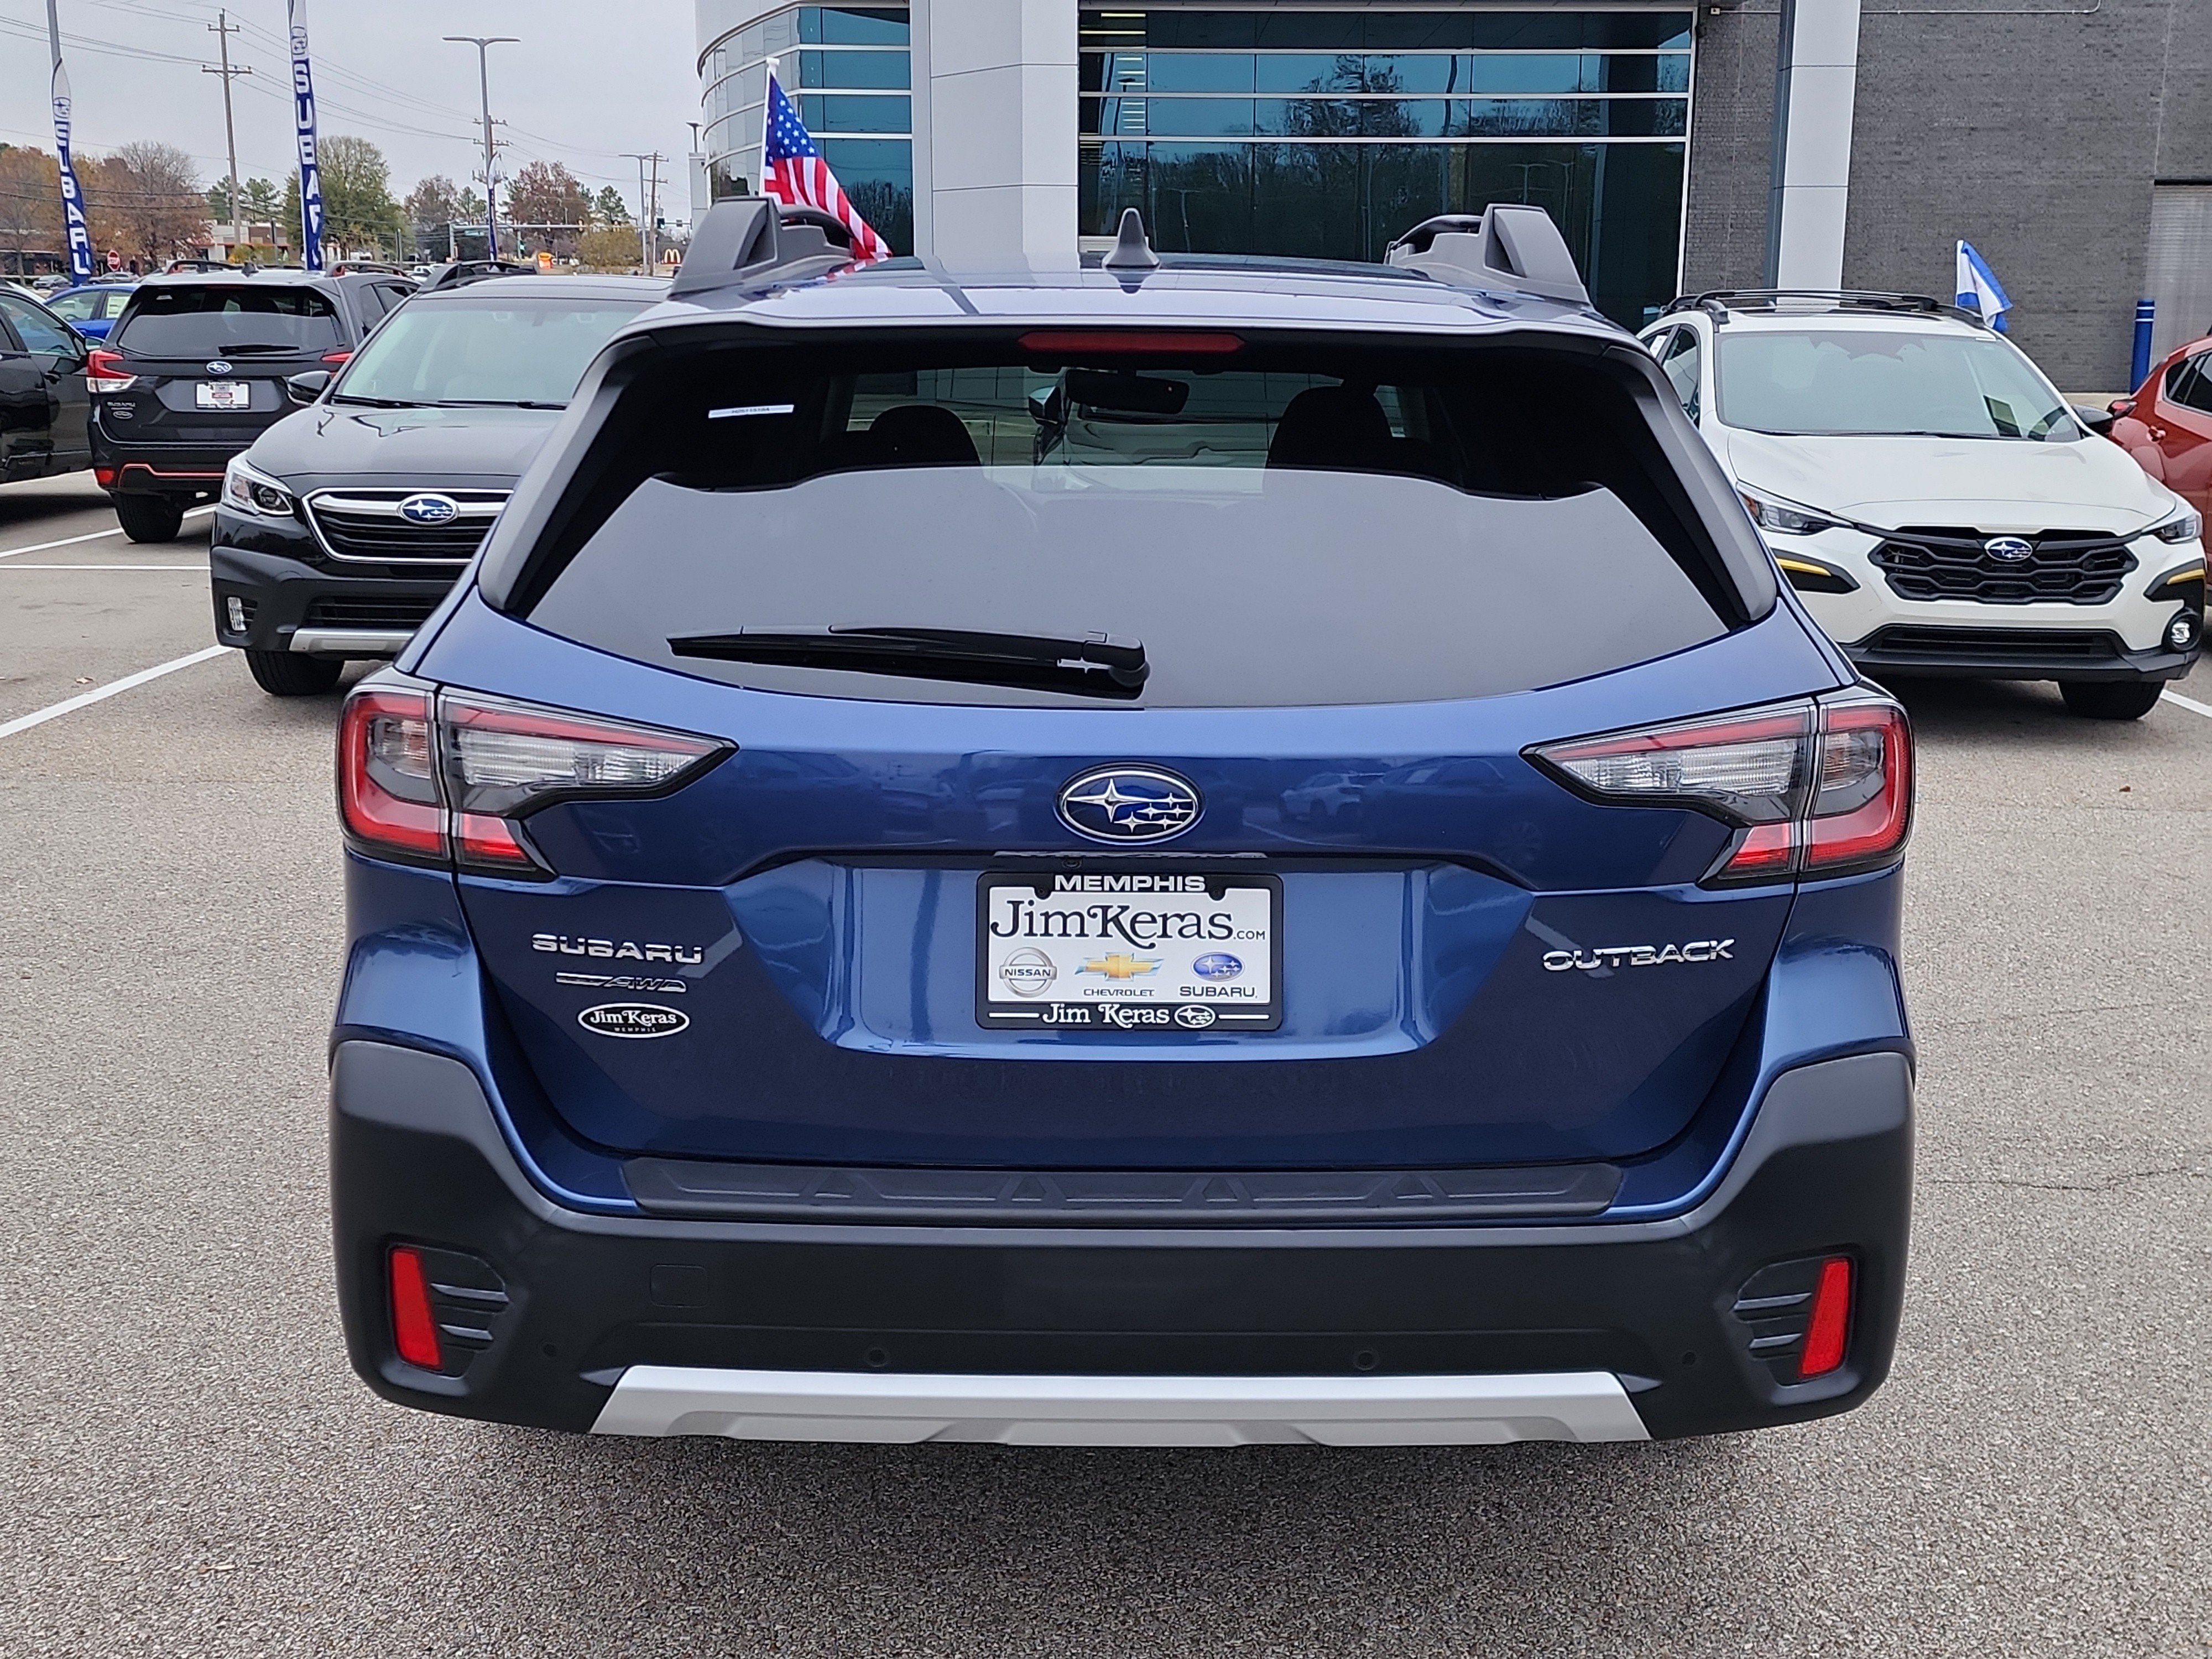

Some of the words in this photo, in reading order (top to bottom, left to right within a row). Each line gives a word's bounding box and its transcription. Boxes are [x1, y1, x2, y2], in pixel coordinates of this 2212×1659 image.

[1055, 875, 1206, 892] MEMPHIS
[532, 933, 702, 964] SUBARU
[1542, 939, 1735, 971] OUTBACK
[1083, 988, 1155, 997] CHEVROLET
[1179, 986, 1256, 998] SUBARU
[1042, 1004, 1091, 1024] Jim
[1098, 1004, 1170, 1029] Keras
